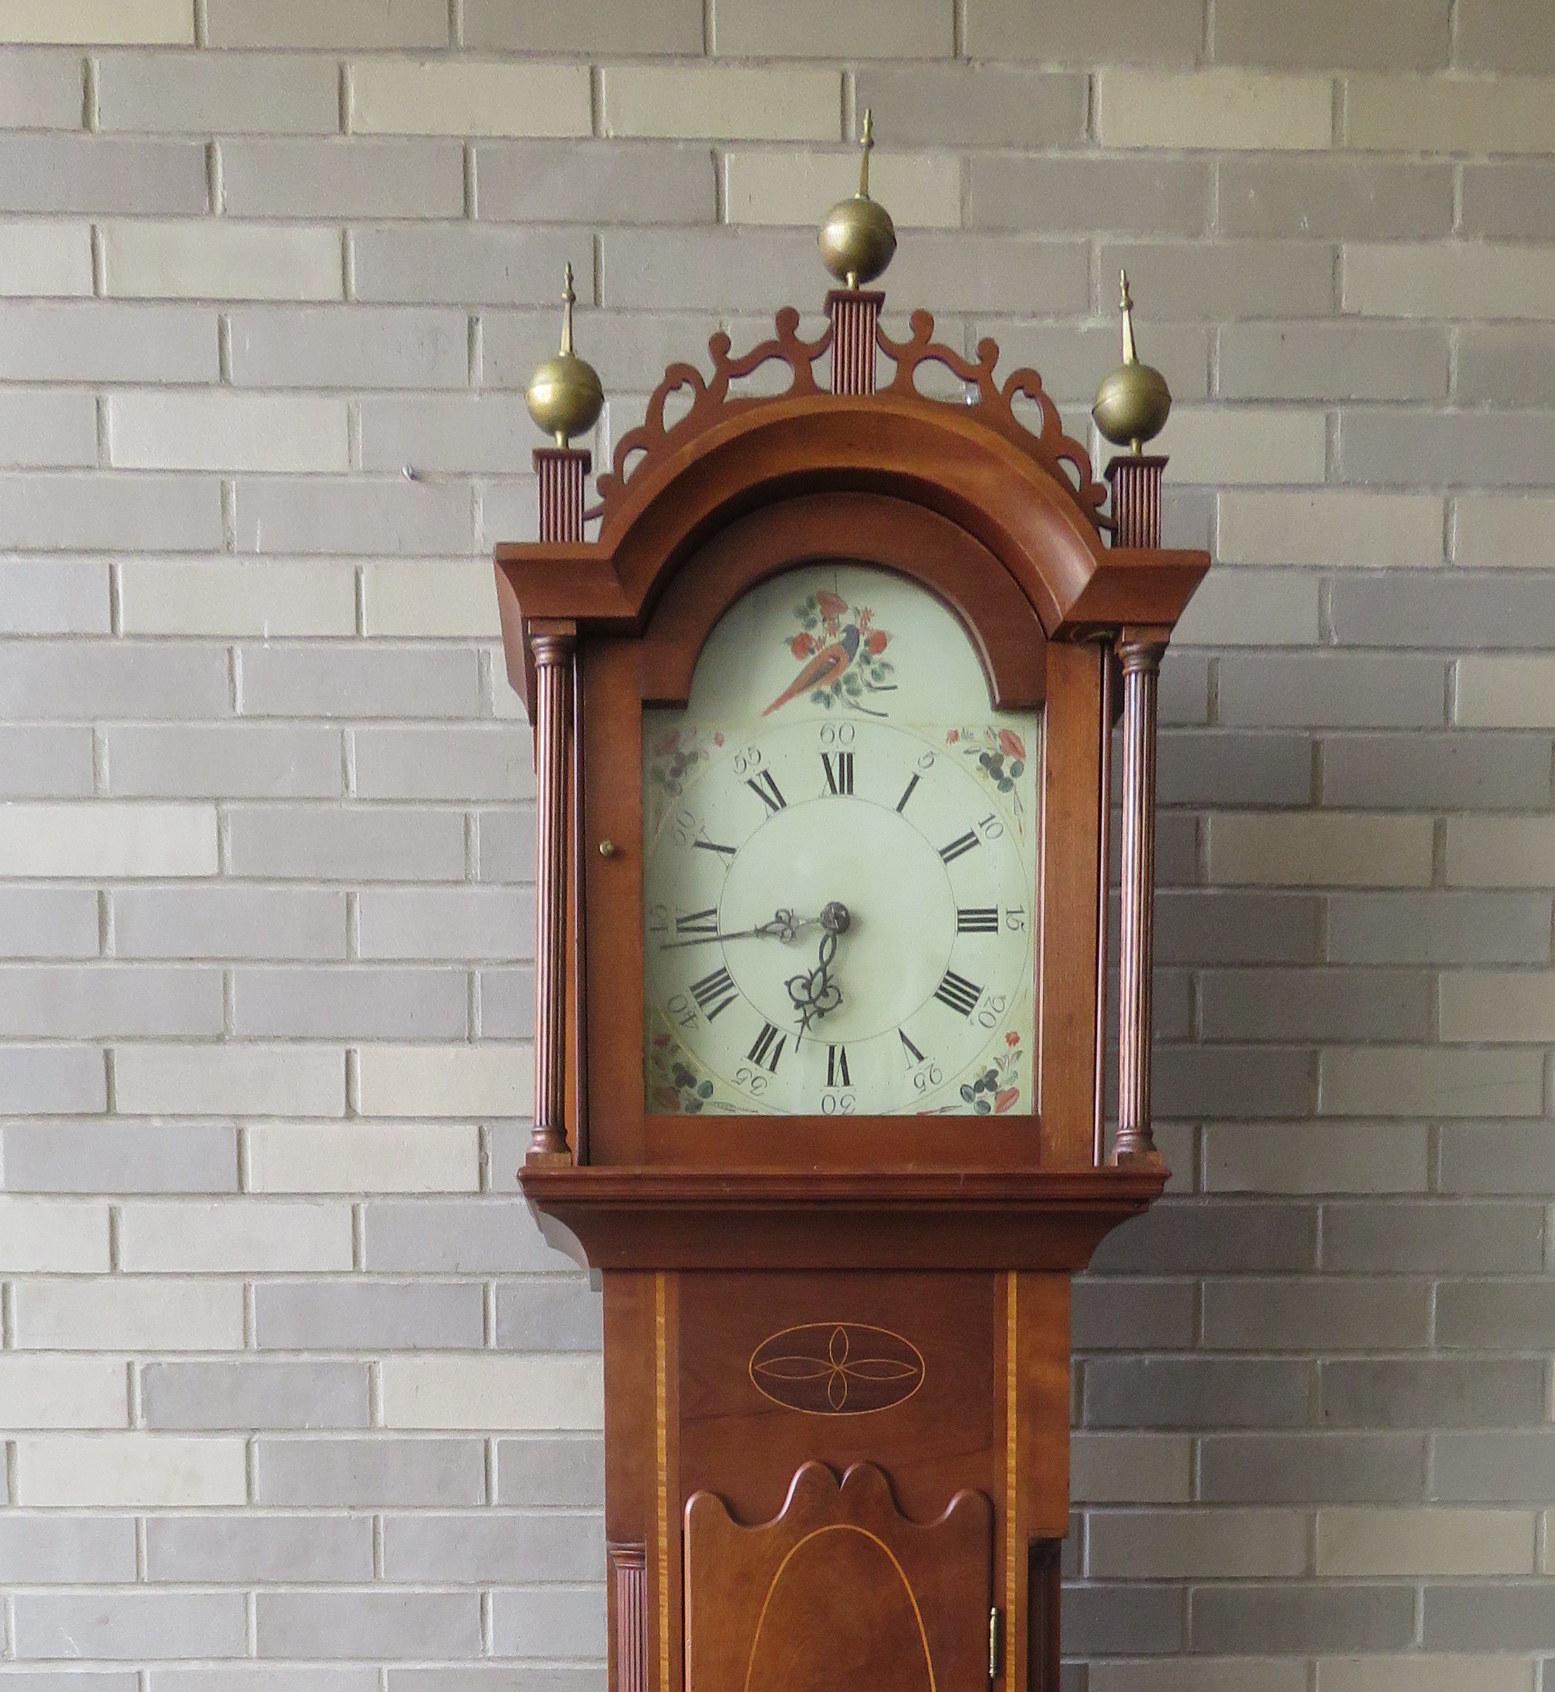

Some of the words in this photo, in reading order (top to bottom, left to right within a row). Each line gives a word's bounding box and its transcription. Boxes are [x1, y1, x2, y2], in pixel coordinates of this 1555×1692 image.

[820, 722, 855, 745] 60
[818, 751, 857, 798] XII
[744, 768, 787, 819] XI
[977, 812, 1004, 840] 10
[937, 826, 982, 865] II
[956, 904, 999, 936] III
[1005, 903, 1025, 933] 15
[688, 966, 740, 1023] VIII
[933, 969, 985, 1019] IIII
[977, 993, 1006, 1029] 20
[742, 1022, 788, 1075] VII
[823, 1044, 854, 1087] VI
[897, 1026, 928, 1071] V
[731, 1067, 768, 1097] 35
[912, 1061, 943, 1095] 25
[821, 1094, 856, 1115] 30
